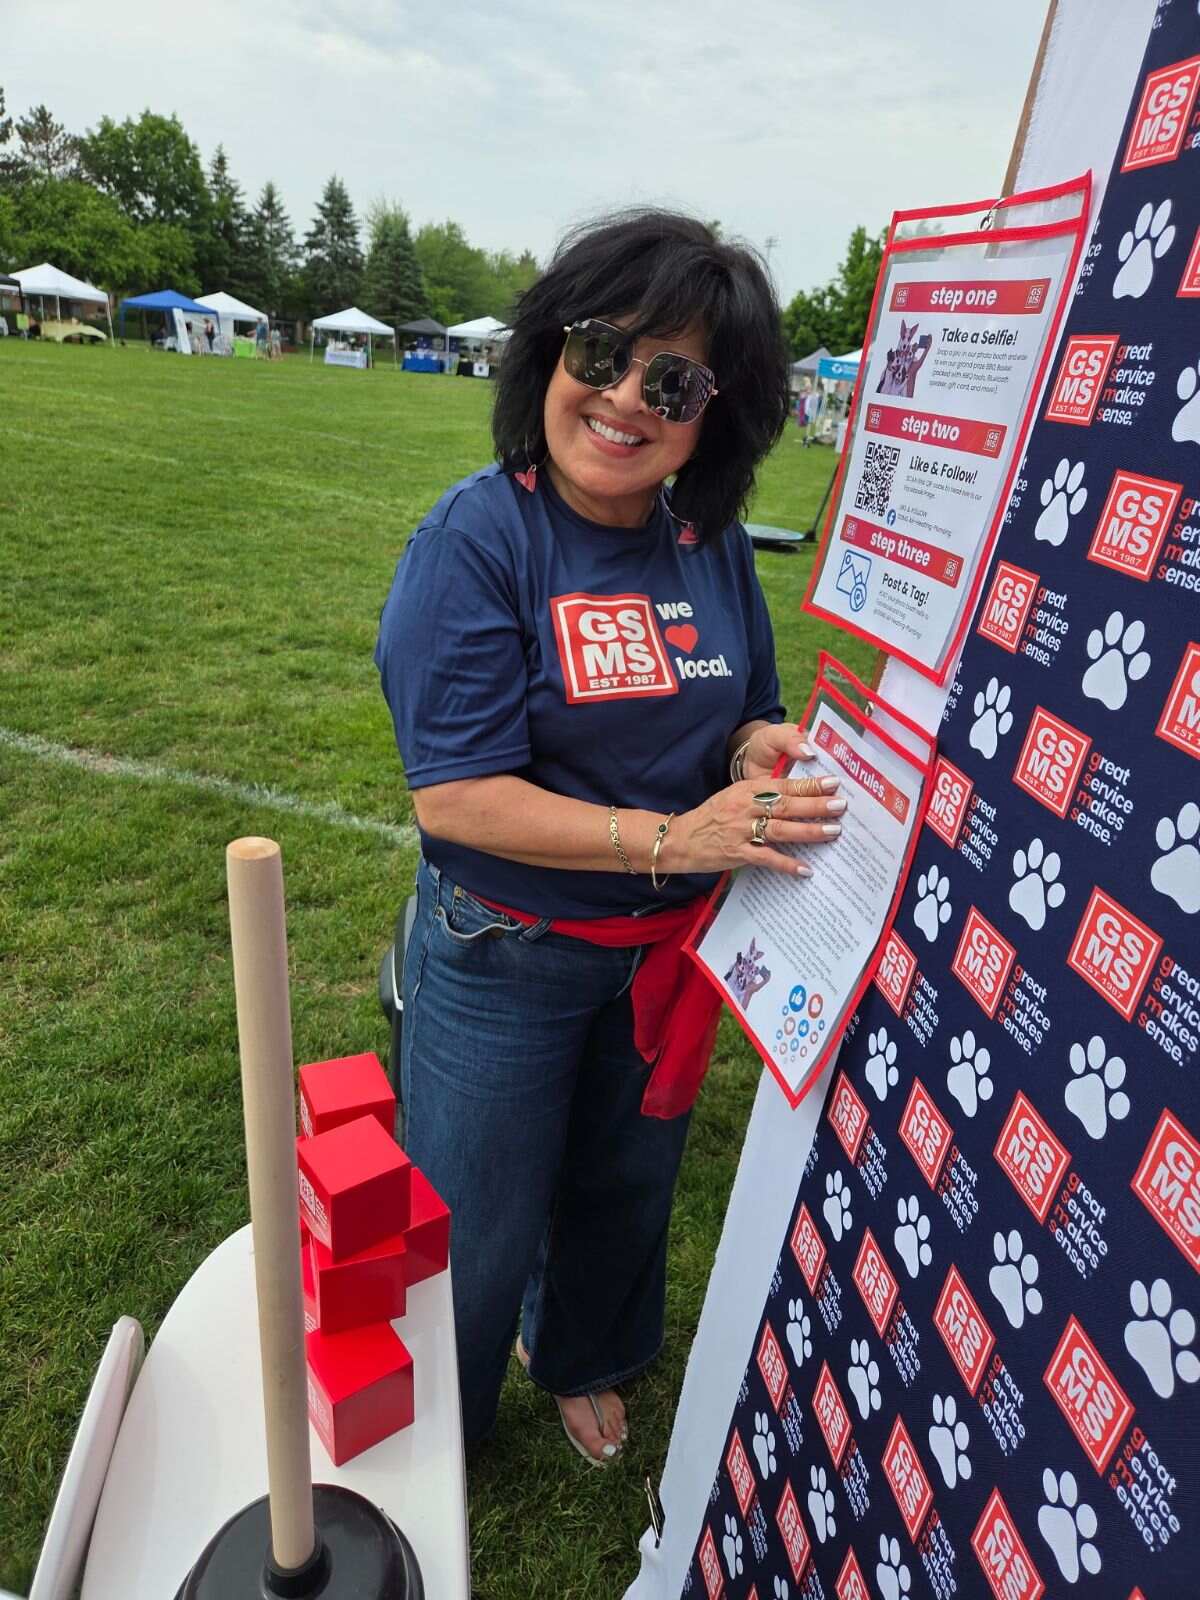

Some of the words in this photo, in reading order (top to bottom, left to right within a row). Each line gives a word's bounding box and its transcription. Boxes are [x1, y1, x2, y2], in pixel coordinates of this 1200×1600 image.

[1148, 76, 1191, 115] GS
[1136, 110, 1181, 148] MS
[930, 287, 964, 311] step
[966, 290, 997, 306] one
[942, 328, 968, 343] Take
[971, 332, 978, 343] a
[981, 330, 1018, 345] Selfie!
[1117, 343, 1152, 364] great
[1068, 350, 1104, 377] GS
[1109, 364, 1155, 386] service
[1058, 377, 1096, 405] MS
[1102, 386, 1145, 407] makes
[901, 416, 929, 441] step
[931, 421, 960, 441] two
[910, 456, 929, 473] Like
[931, 463, 938, 475] &
[941, 464, 978, 484] Follow!
[1116, 489, 1163, 527] GS
[870, 531, 895, 557] step
[898, 538, 930, 566] three
[1104, 515, 1152, 555] MS
[1100, 545, 1117, 558] EST
[1119, 551, 1142, 567] 1987
[1165, 544, 1200, 569] mak
[882, 573, 901, 591] Post
[902, 582, 908, 595] &
[910, 585, 930, 606] Tag!
[998, 576, 1027, 608] GS
[1036, 586, 1067, 610] great
[578, 610, 646, 642] GS
[656, 602, 693, 620] we
[989, 601, 1020, 632] MS
[1031, 607, 1069, 635] service
[1026, 623, 1061, 652] makes
[582, 642, 656, 677] MS
[676, 655, 732, 679] local.
[589, 677, 620, 689] EST
[625, 675, 657, 686] 1987
[1037, 727, 1075, 767] GS
[1174, 725, 1193, 741] EST
[833, 743, 858, 775] official
[859, 771, 886, 801] rules.
[1027, 748, 1067, 793] MS
[1088, 752, 1131, 785] great
[937, 772, 964, 807] GS
[971, 794, 997, 822] great
[1083, 773, 1134, 814] service
[930, 794, 956, 828] MS
[967, 810, 998, 846] service
[1077, 790, 1125, 831] makes
[962, 824, 992, 859] makes
[886, 941, 909, 977] GS
[972, 927, 1003, 972] GS
[1096, 913, 1145, 966] GS
[879, 958, 902, 996] MS
[963, 945, 996, 993] MS
[1081, 959, 1100, 979] EST
[1083, 934, 1134, 991] MS
[915, 971, 938, 1003] great
[1014, 964, 1047, 1004] great
[906, 998, 934, 1038] makes
[911, 985, 939, 1026] service
[1002, 995, 1043, 1045] makes
[1008, 982, 1051, 1031] service
[1144, 994, 1199, 1053] makes
[835, 1102, 856, 1143] MS
[840, 1088, 862, 1126] GS
[915, 1100, 943, 1147] GS
[867, 1125, 887, 1161] great
[908, 1115, 935, 1165] MS
[1018, 1117, 1055, 1174] GS
[859, 1150, 882, 1192] makes
[863, 1138, 887, 1183] service
[951, 1146, 978, 1188] great
[1007, 1135, 1045, 1195] MS
[942, 1172, 972, 1224] makes
[946, 1160, 979, 1213] service
[1068, 1172, 1106, 1224] great
[1062, 1190, 1108, 1256] service
[1146, 1187, 1166, 1212] EST
[1168, 1215, 1193, 1245] 1987
[796, 1232, 814, 1276] MS
[803, 1221, 820, 1261] GS
[1054, 1204, 1099, 1269] makes
[860, 1263, 883, 1315] MS
[867, 1249, 890, 1299] GS
[944, 1304, 976, 1369] MS
[952, 1290, 983, 1350] GS
[992, 1353, 1024, 1409] great
[1072, 1346, 1116, 1421] GS
[819, 1393, 839, 1447] MS
[825, 1382, 844, 1433] GS
[983, 1382, 1019, 1449] makes
[988, 1370, 1026, 1439] service
[1060, 1363, 1106, 1441] MS
[898, 1441, 923, 1500] GS
[1130, 1427, 1177, 1496] great
[891, 1452, 916, 1516] MS
[1116, 1458, 1170, 1544] makes
[1123, 1444, 1181, 1533] service
[994, 1518, 1029, 1593] GS
